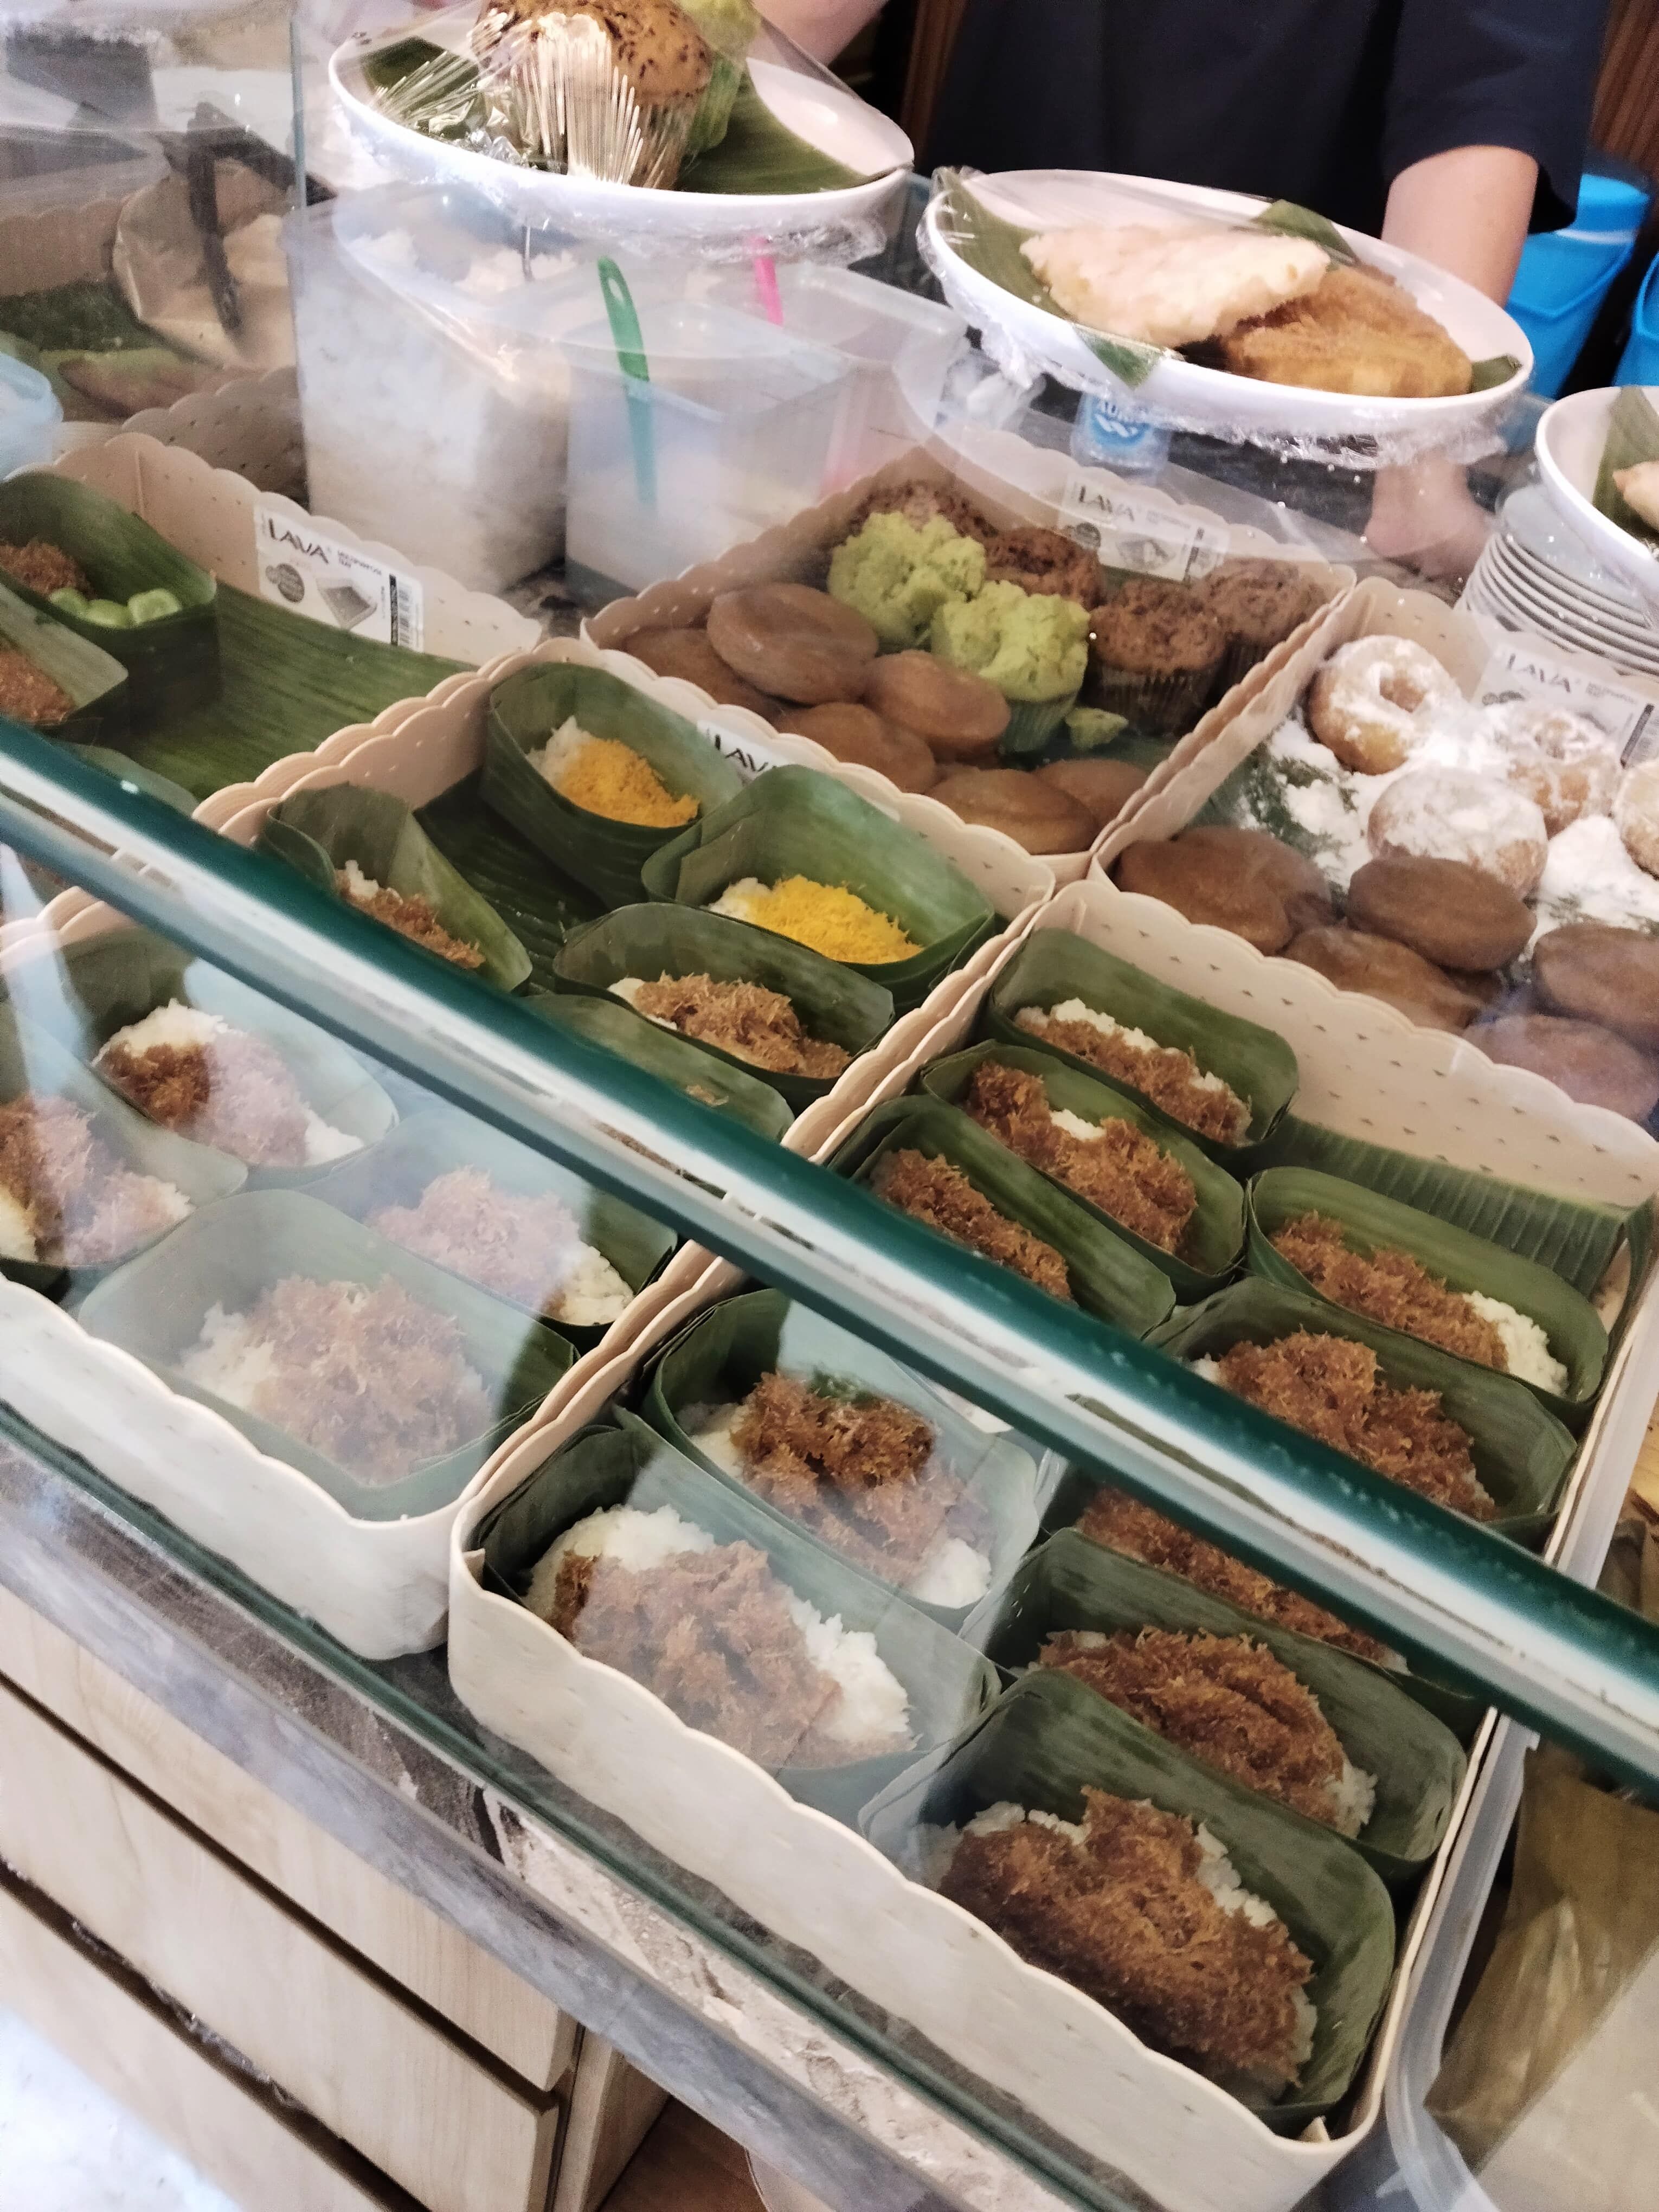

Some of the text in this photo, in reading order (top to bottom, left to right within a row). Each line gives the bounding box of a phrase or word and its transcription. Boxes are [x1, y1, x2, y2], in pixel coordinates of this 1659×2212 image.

[268, 517, 330, 564] LAVA
[1507, 653, 1571, 693] LAVA
[714, 734, 770, 773] LAV
